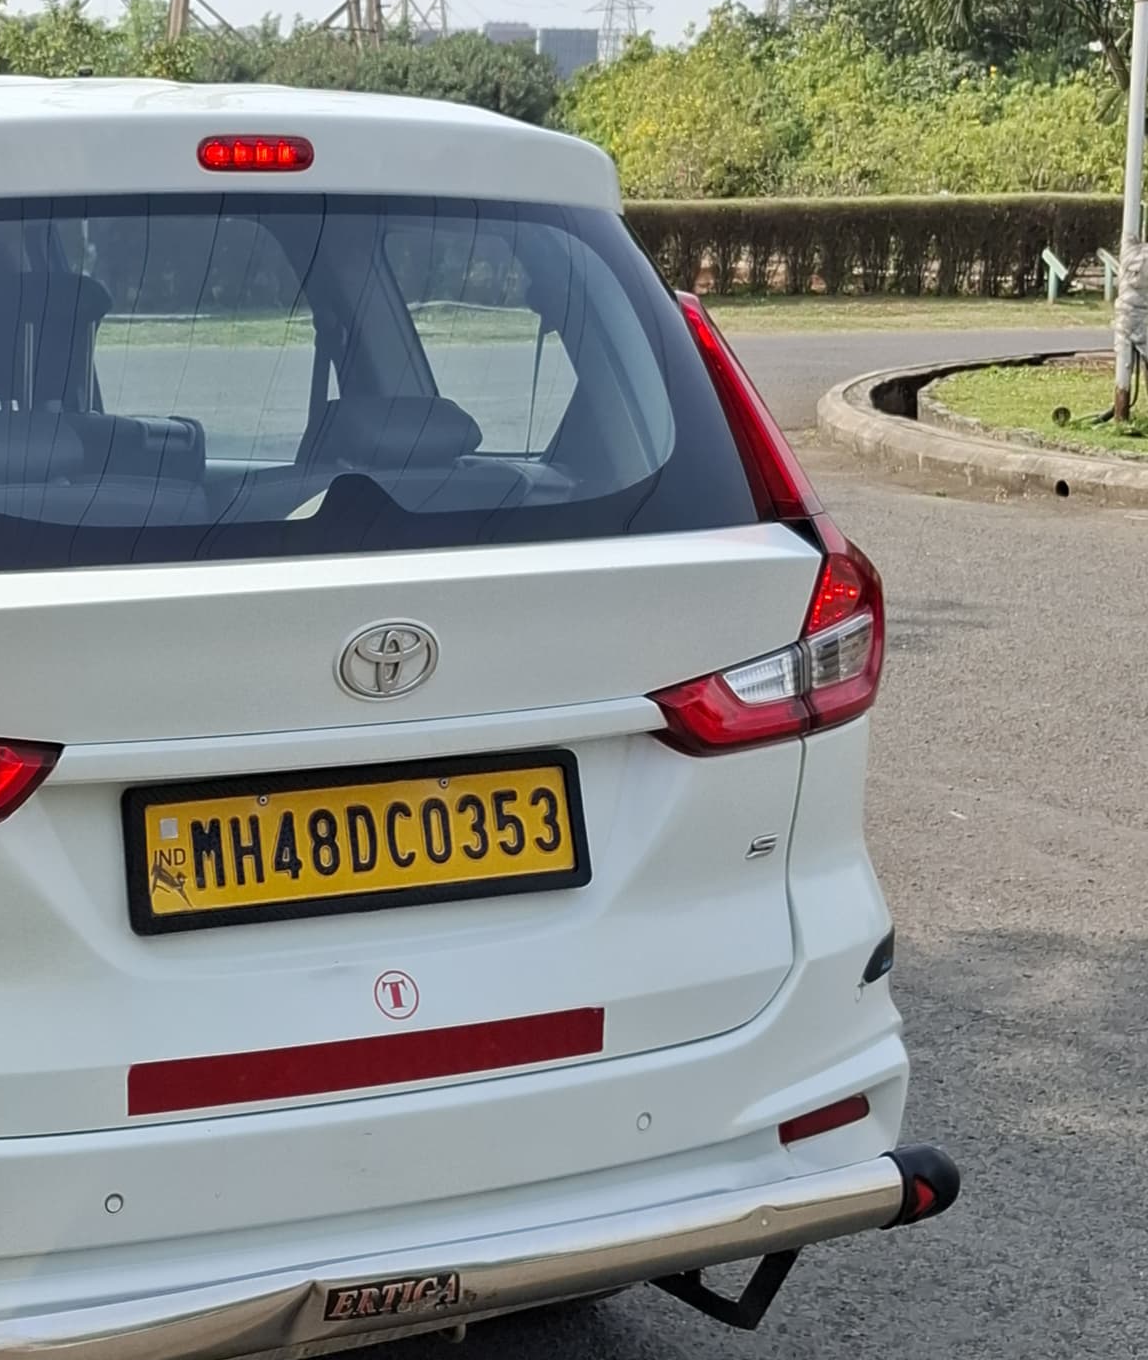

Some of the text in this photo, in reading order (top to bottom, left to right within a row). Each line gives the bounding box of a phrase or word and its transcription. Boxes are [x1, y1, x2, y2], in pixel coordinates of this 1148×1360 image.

[190, 785, 562, 890] MH48DC0353
[153, 847, 187, 868] IND
[381, 978, 408, 1009] T
[327, 1271, 459, 1318] ERTIGA
